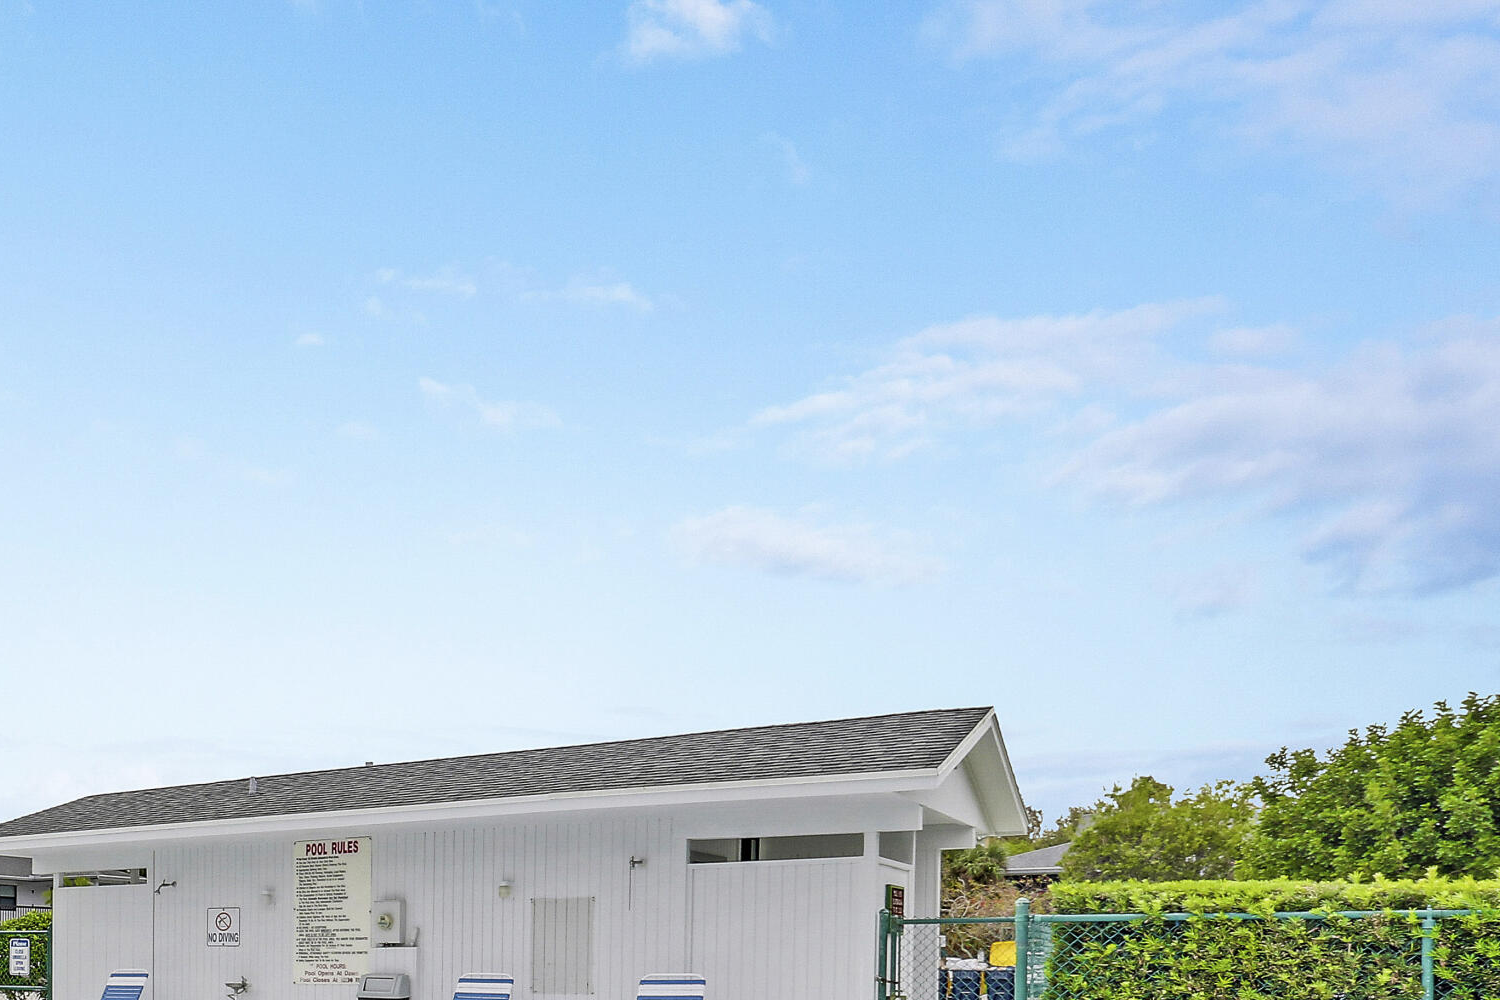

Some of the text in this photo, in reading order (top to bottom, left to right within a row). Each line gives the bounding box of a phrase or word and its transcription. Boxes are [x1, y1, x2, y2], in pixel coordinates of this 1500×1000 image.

[305, 840, 359, 856] POOL RULES
[208, 932, 239, 942] NO DIVING
